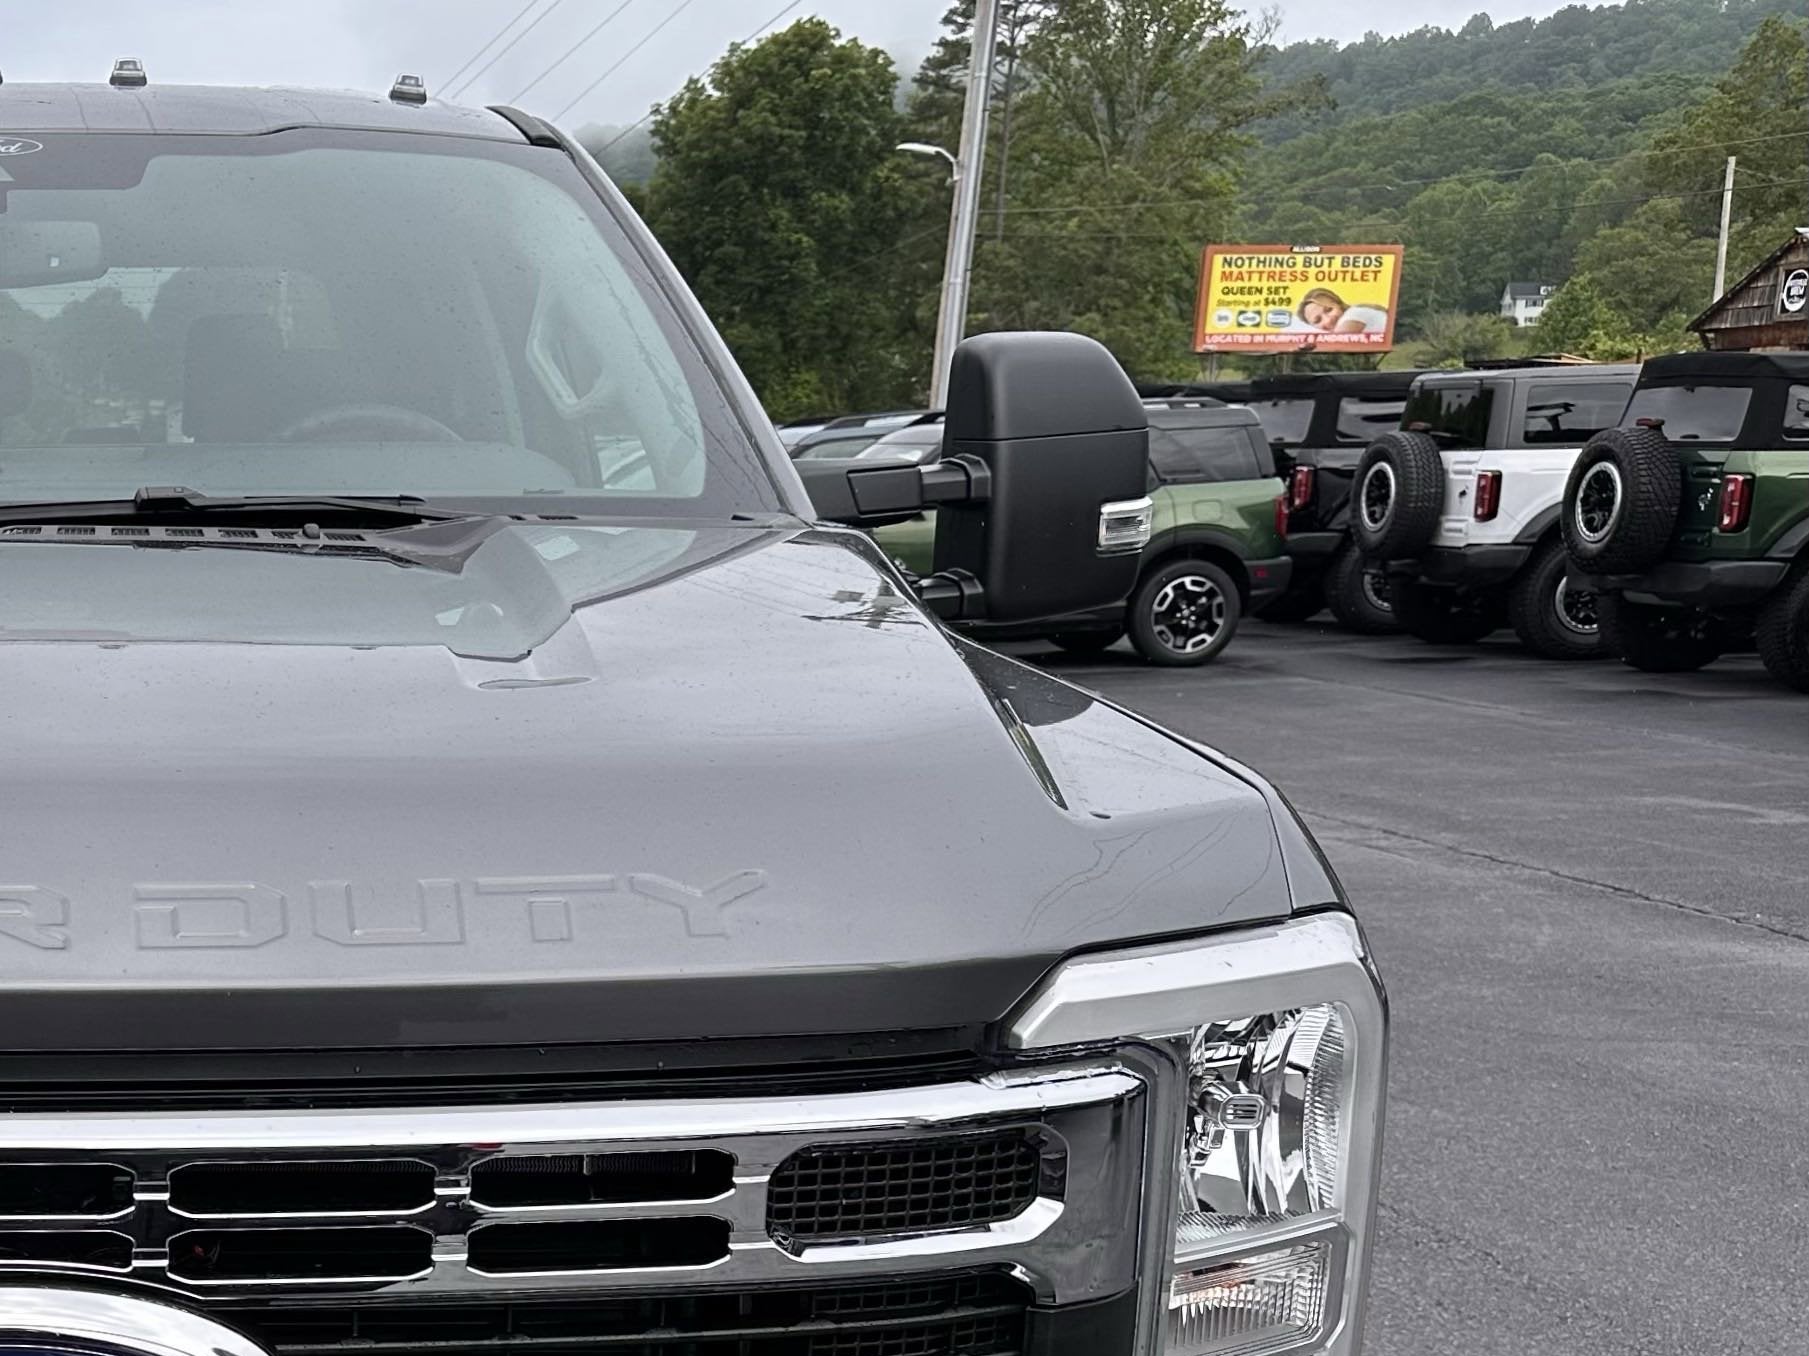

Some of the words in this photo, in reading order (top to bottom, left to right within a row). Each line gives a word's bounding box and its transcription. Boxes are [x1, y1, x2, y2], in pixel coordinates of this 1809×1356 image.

[1221, 256, 1297, 269] NOTHING
[1302, 256, 1336, 268] BUT
[1340, 256, 1383, 268] BEDS
[1220, 270, 1309, 282] MATTRESS
[1314, 270, 1382, 282] OUTLET
[1221, 286, 1263, 296] QUEEN
[1266, 286, 1290, 295] SET
[1216, 298, 1251, 308] Starting
[1263, 297, 1292, 307] $499
[1205, 334, 1252, 344] LOCATED
[1253, 334, 1264, 343] IN
[1265, 334, 1307, 344] MURPHY
[1369, 333, 1385, 343] NC
[132, 867, 770, 950] DUTY
